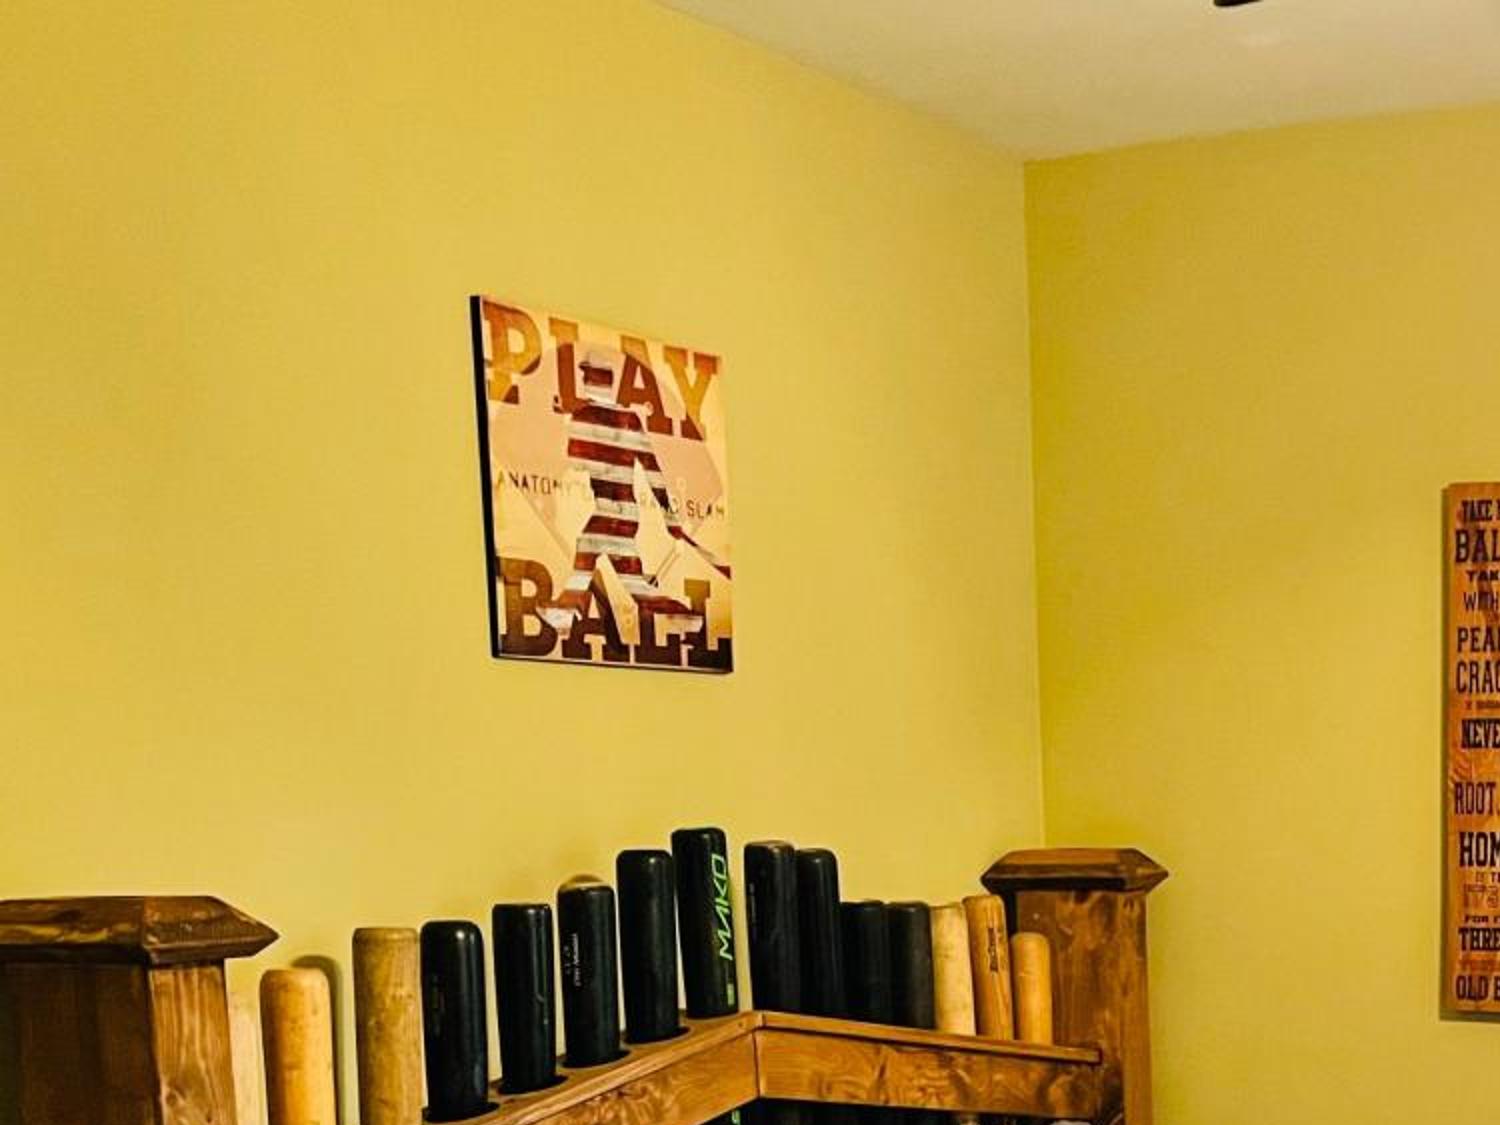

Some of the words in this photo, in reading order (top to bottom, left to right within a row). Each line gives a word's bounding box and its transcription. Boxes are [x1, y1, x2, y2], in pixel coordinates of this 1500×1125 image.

[483, 299, 720, 441] PLAY
[1462, 499, 1493, 522] TAKE
[496, 555, 733, 669] BALL
[1463, 591, 1499, 612] WITH
[711, 853, 733, 961] MAKO
[1455, 975, 1489, 1002] OLD
